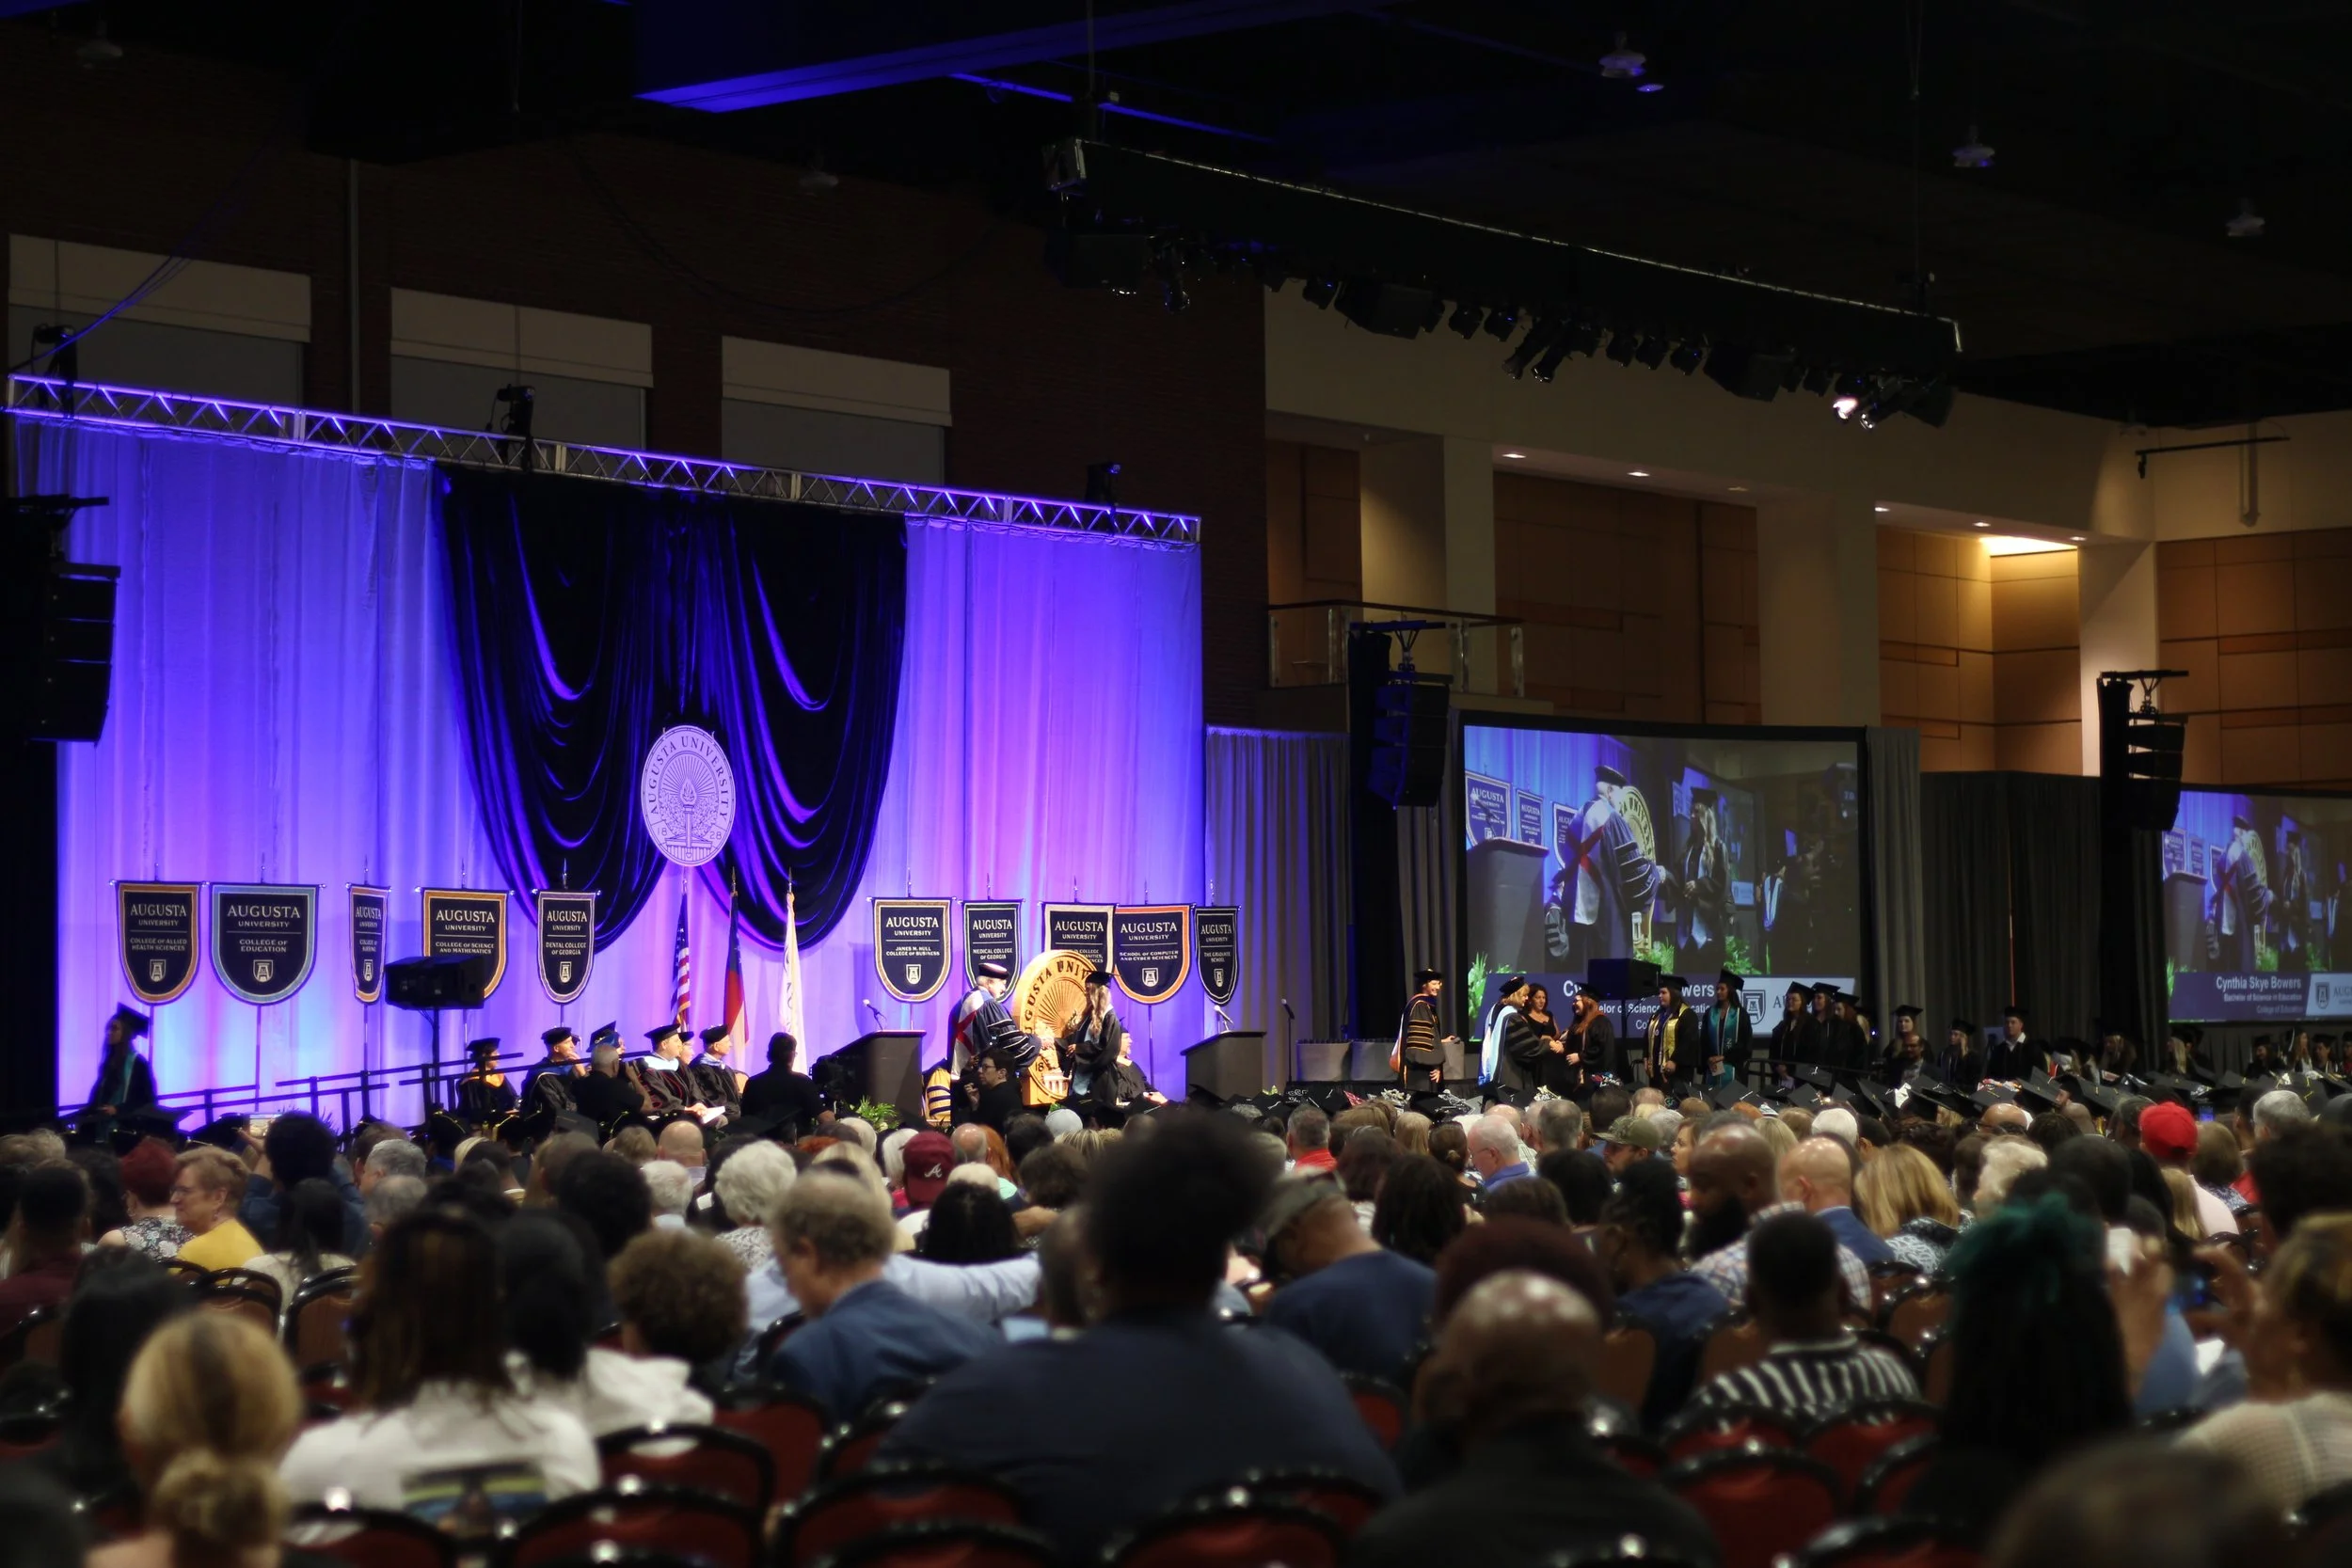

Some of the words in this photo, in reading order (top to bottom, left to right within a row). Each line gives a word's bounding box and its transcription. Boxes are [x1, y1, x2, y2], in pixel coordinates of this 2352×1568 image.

[648, 741, 677, 816] AUGUSTA
[681, 736, 729, 821] UNIVERSITY
[130, 904, 187, 917] AUGUSTA
[227, 905, 301, 919] AUGUSTA
[356, 906, 382, 921] AUGUSTA
[436, 910, 495, 923] AUGUSTA
[547, 910, 588, 923] AUGUSTA
[885, 916, 940, 928] AUGUSTA
[972, 919, 1013, 931] AUGUSTA
[1054, 921, 1104, 932] AUGUSTA
[1120, 922, 1178, 934] AUGUSTA
[1200, 924, 1232, 935] AUGUSTA
[1681, 984, 1716, 997] wers
[2216, 975, 2248, 993] Cynthia
[2249, 975, 2269, 993] Skye
[2270, 975, 2302, 990] Bowers
[1024, 966, 1054, 1035] UGUSTA
[1598, 1003, 1615, 1014] elor
[1628, 1003, 1661, 1014] Scienc
[924, 1163, 943, 1179] A
